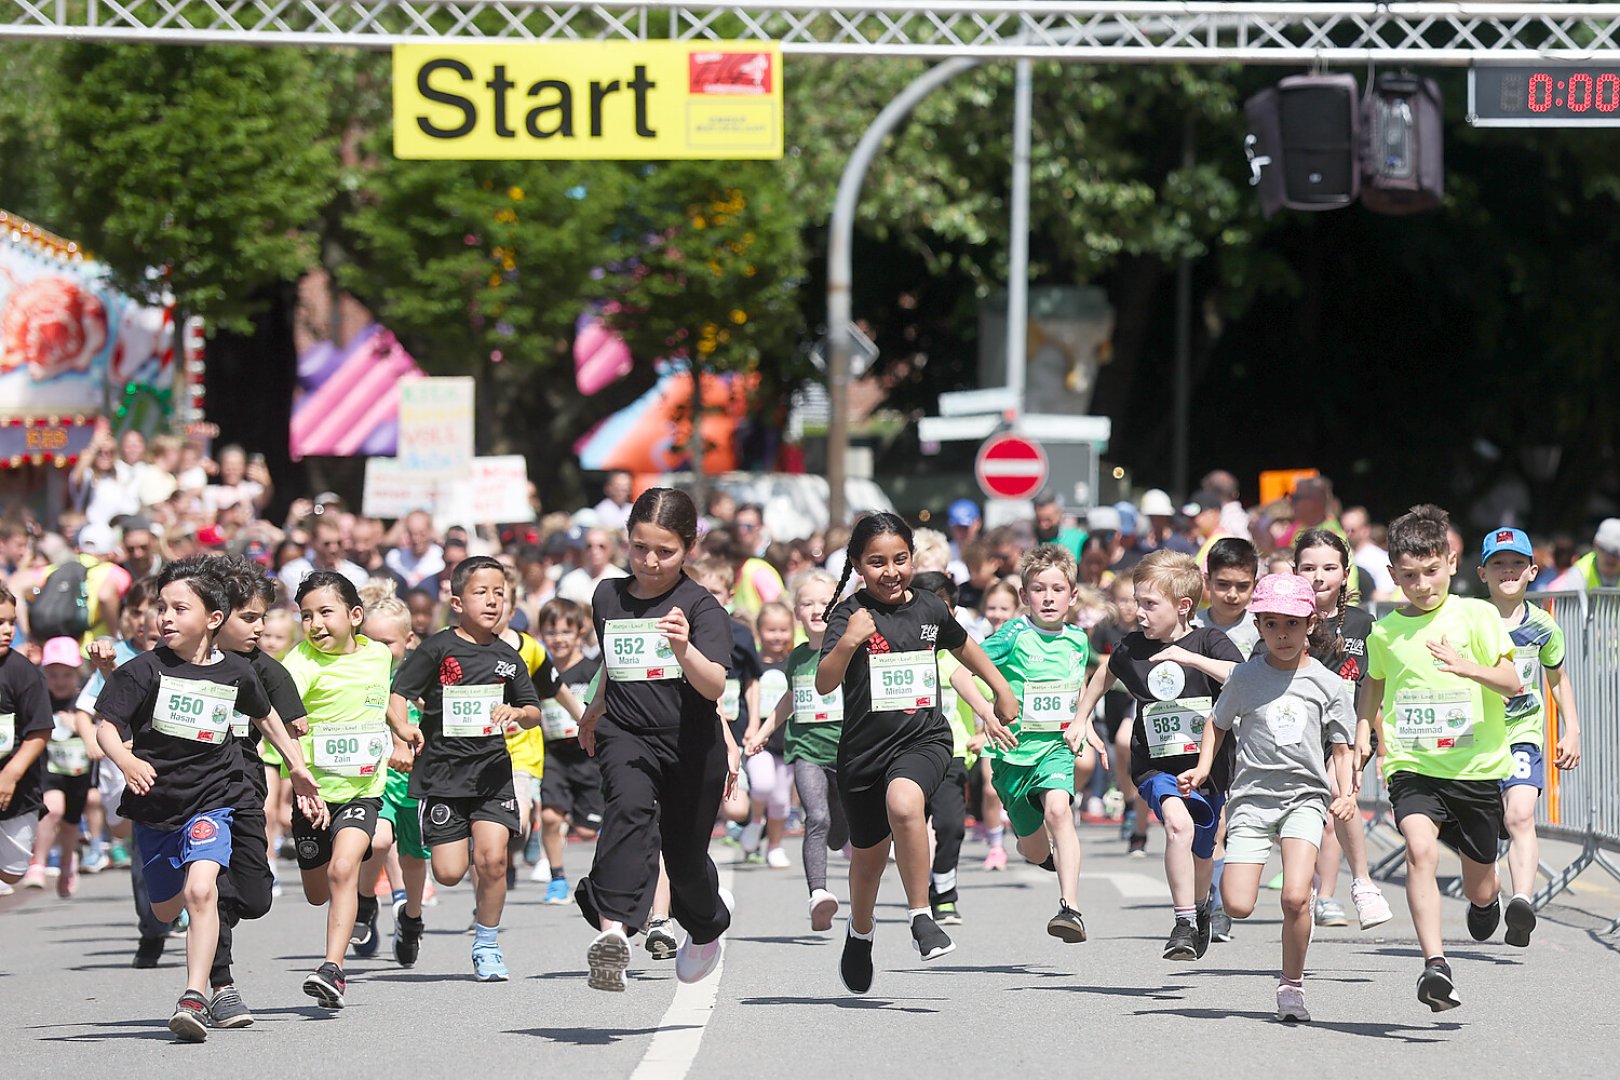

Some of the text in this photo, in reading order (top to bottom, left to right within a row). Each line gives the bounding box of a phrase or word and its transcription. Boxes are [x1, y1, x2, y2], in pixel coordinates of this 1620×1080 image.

[416, 58, 657, 139] Start
[613, 637, 645, 656] 552
[618, 656, 640, 665] Maria
[882, 669, 914, 687] 569
[885, 687, 913, 696] Miriam
[168, 694, 204, 715] 550
[452, 701, 482, 716] 582
[1033, 696, 1062, 711] 836
[169, 711, 196, 724] Hasan
[1404, 707, 1436, 725] 739
[1152, 715, 1181, 734] 583
[1399, 726, 1443, 735] Mohammad
[325, 738, 360, 755] 690
[334, 755, 351, 763] Zain
[342, 807, 366, 821] 12
